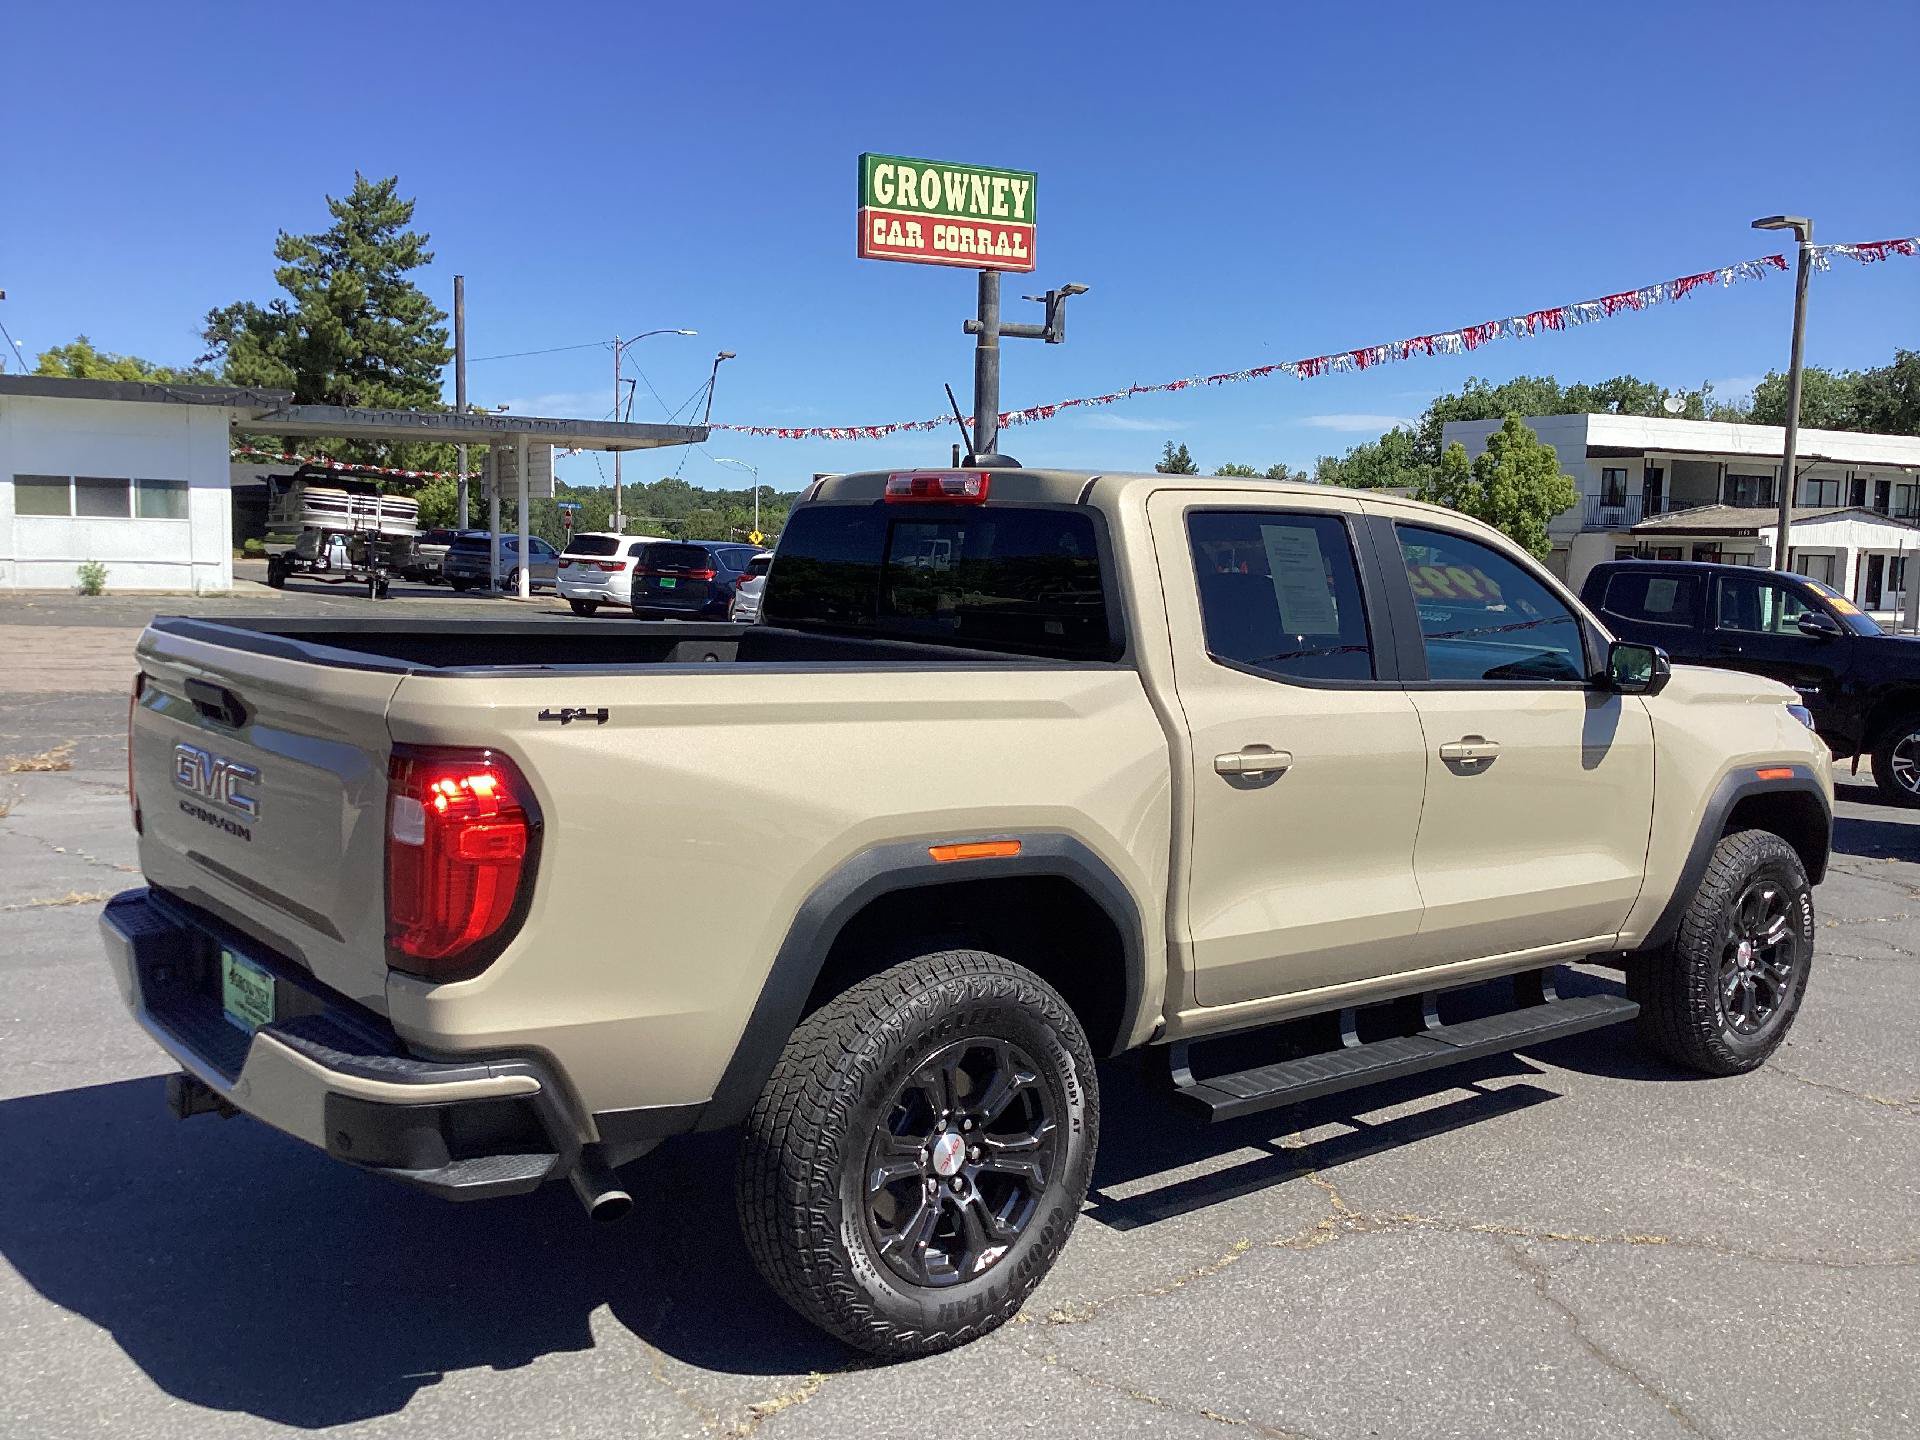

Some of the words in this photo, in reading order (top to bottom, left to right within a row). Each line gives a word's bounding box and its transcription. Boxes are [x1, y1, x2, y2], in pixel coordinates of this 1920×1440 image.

[873, 163, 1030, 219] GROWNEY
[873, 218, 925, 249] CAR
[933, 224, 1028, 259] CORRAL
[175, 744, 260, 818] GMC
